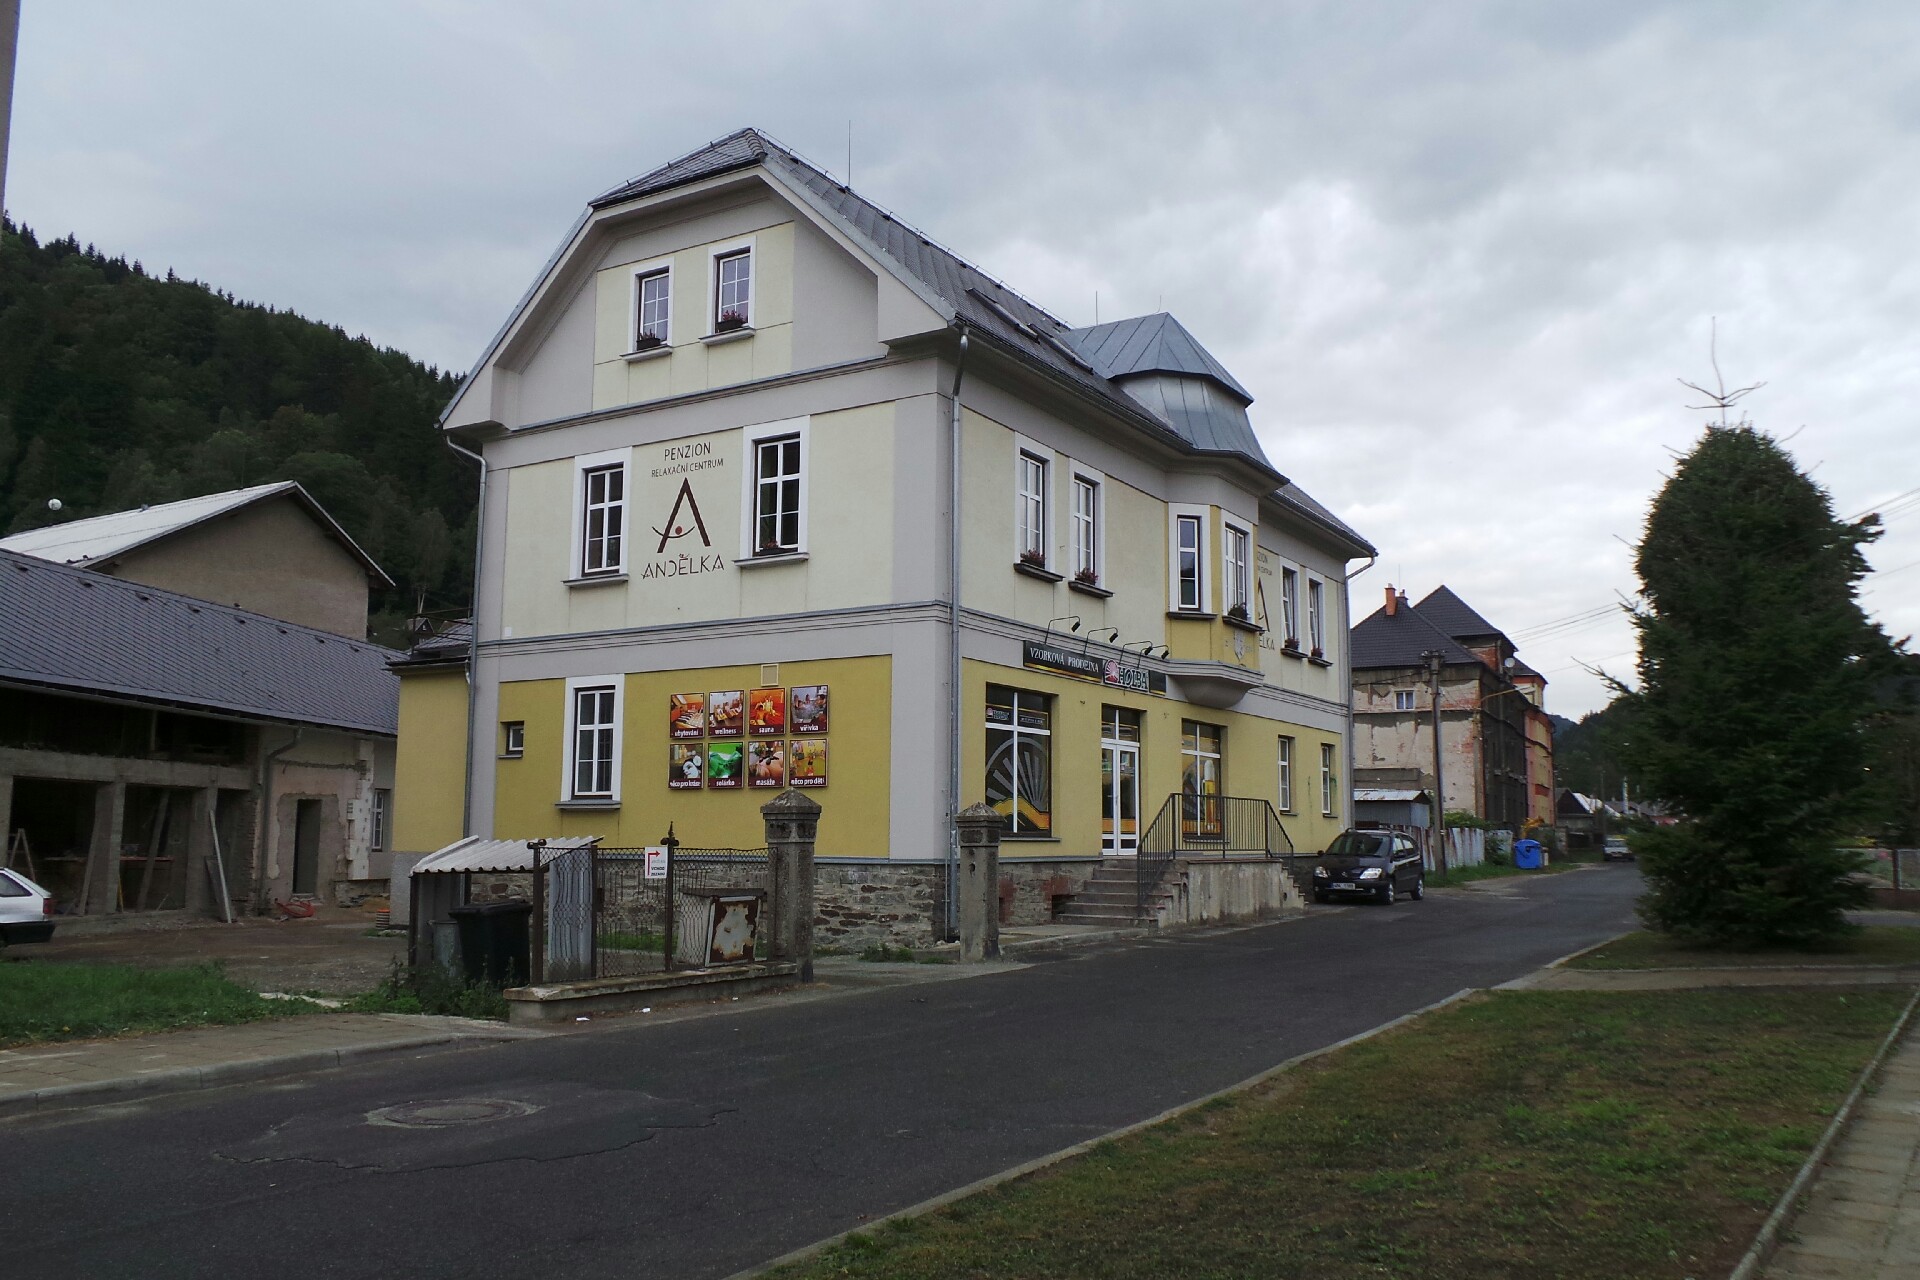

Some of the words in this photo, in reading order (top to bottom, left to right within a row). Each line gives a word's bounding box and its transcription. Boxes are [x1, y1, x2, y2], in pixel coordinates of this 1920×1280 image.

[664, 442, 711, 461] PENZION
[651, 462, 688, 477] RELAXAČNÍ
[689, 458, 724, 472] CENTRUM
[1030, 647, 1065, 666] VZORKOVÁ
[1067, 656, 1099, 673] PRODEJNA
